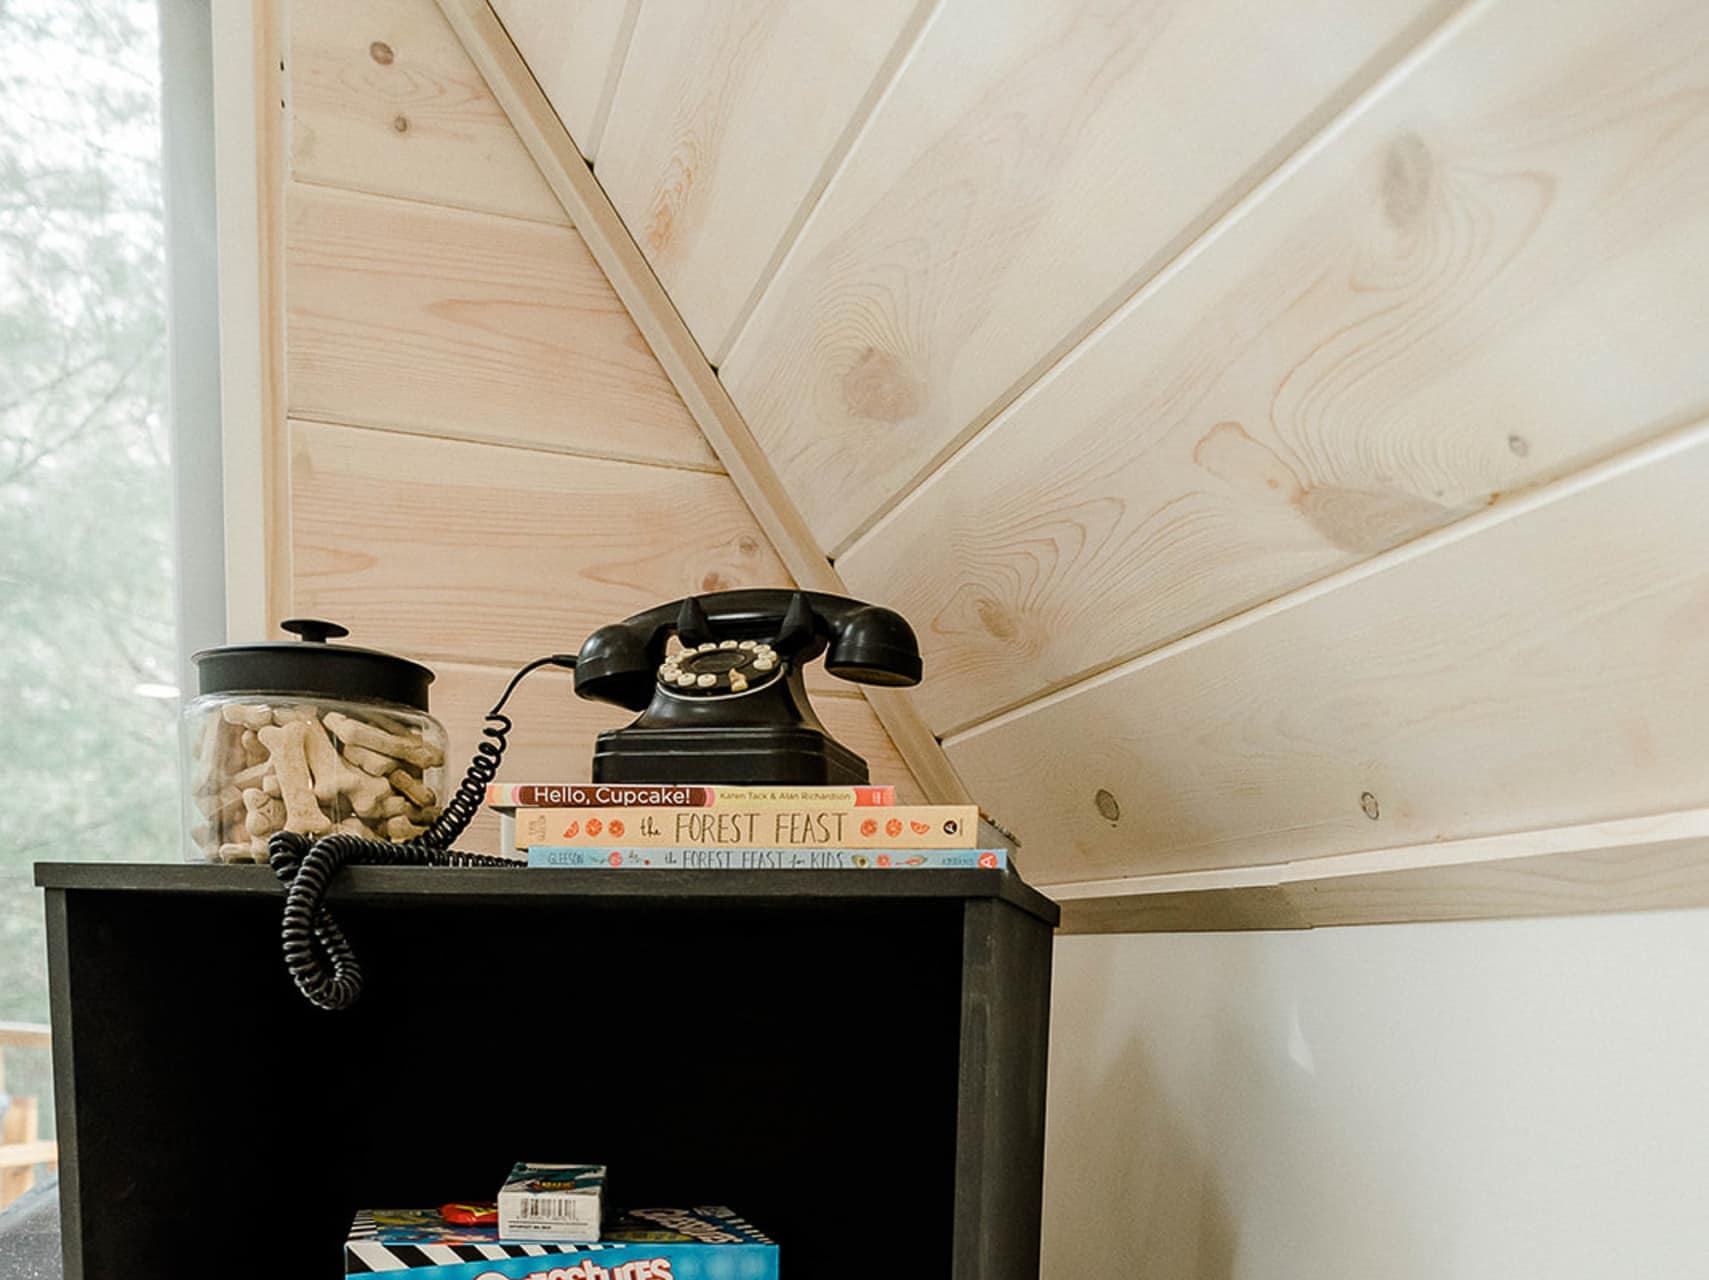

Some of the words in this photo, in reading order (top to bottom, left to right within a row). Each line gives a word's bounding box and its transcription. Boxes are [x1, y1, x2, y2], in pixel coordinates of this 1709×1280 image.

[534, 786, 591, 806] Hello,
[596, 786, 691, 807] Cupcake!
[719, 792, 747, 801] Karen
[748, 792, 768, 801] Tack
[770, 792, 777, 801] &
[780, 792, 800, 801] Alan
[801, 792, 851, 801] Richardson
[640, 816, 662, 837] the
[675, 812, 761, 844] FOREST
[775, 812, 849, 844] FEAST
[683, 850, 733, 868] FOREST
[742, 850, 785, 868] FEAST
[811, 851, 845, 868] KIDS
